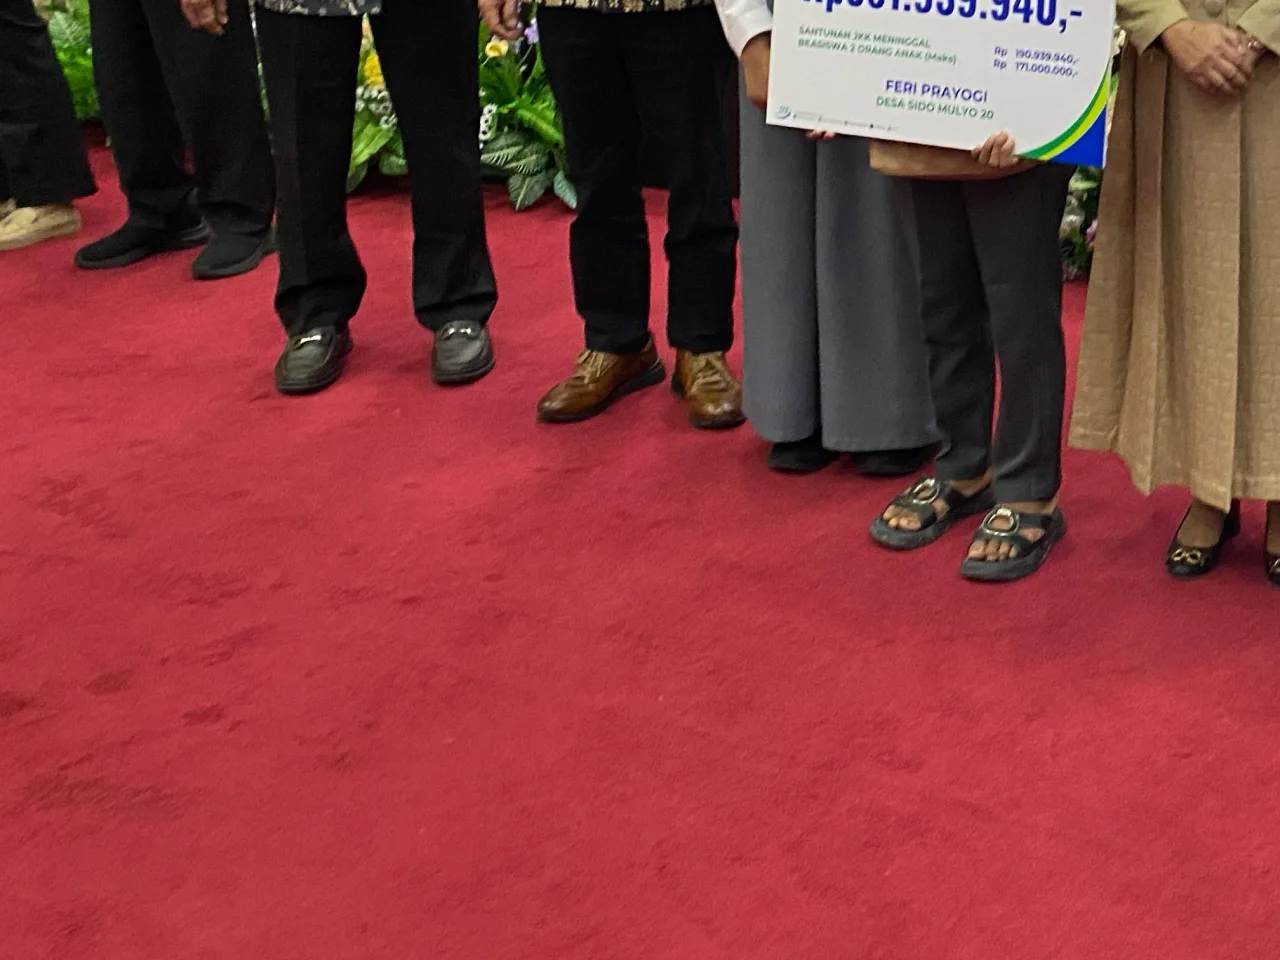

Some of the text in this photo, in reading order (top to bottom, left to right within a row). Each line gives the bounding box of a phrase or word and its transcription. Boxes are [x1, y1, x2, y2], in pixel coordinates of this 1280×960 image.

[799, 25, 851, 40] SANTUNAN
[873, 33, 932, 49] MENINGGAL
[798, 38, 848, 52] BEASISWA
[857, 44, 893, 57] ORANG
[894, 49, 923, 61] ANAK
[994, 46, 1008, 58] Rp
[993, 59, 1007, 71] Rp
[885, 79, 988, 104] FERI PRAYOGI
[876, 96, 994, 120] DESA SIDO MULYO 20
